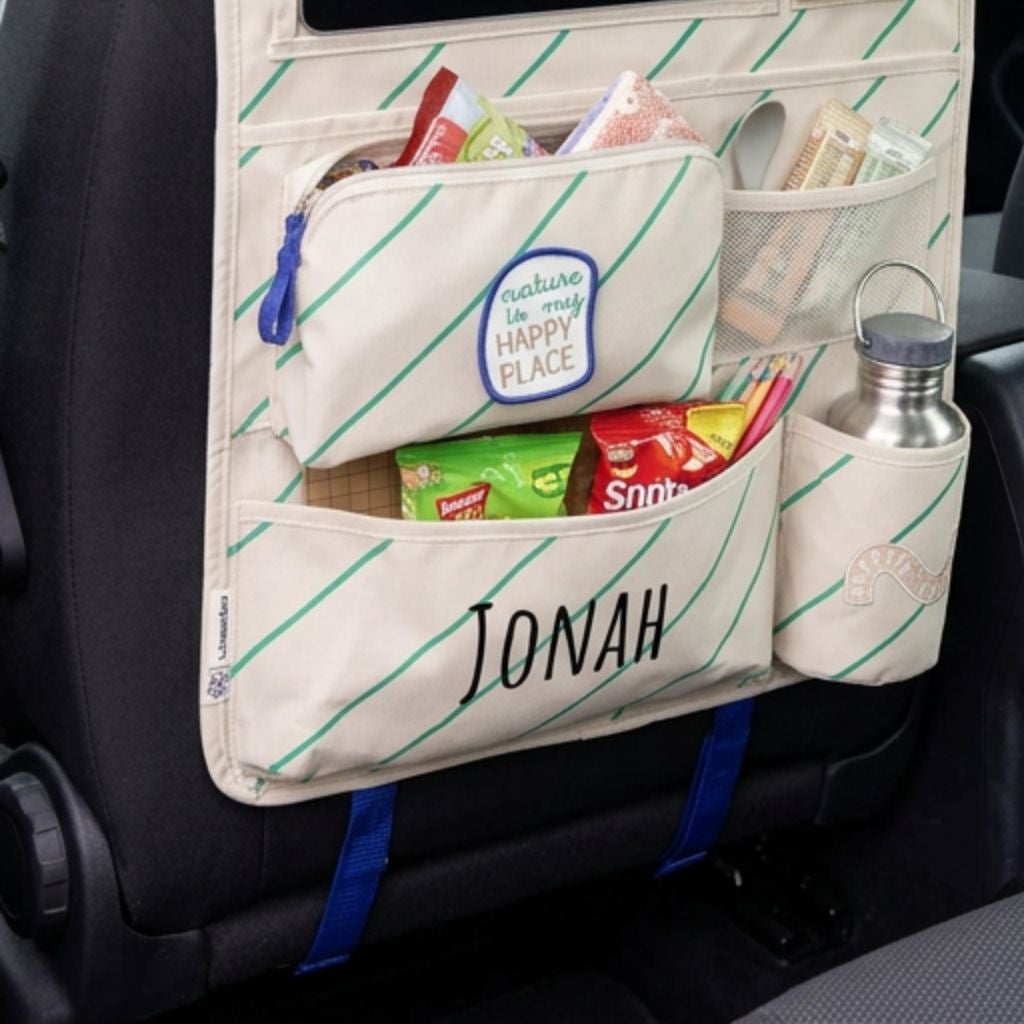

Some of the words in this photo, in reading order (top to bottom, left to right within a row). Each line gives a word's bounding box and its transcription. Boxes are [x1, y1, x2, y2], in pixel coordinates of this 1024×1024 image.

[495, 316, 573, 356] HAPPY
[499, 344, 575, 389] PLACE
[459, 583, 668, 705] JONAH
